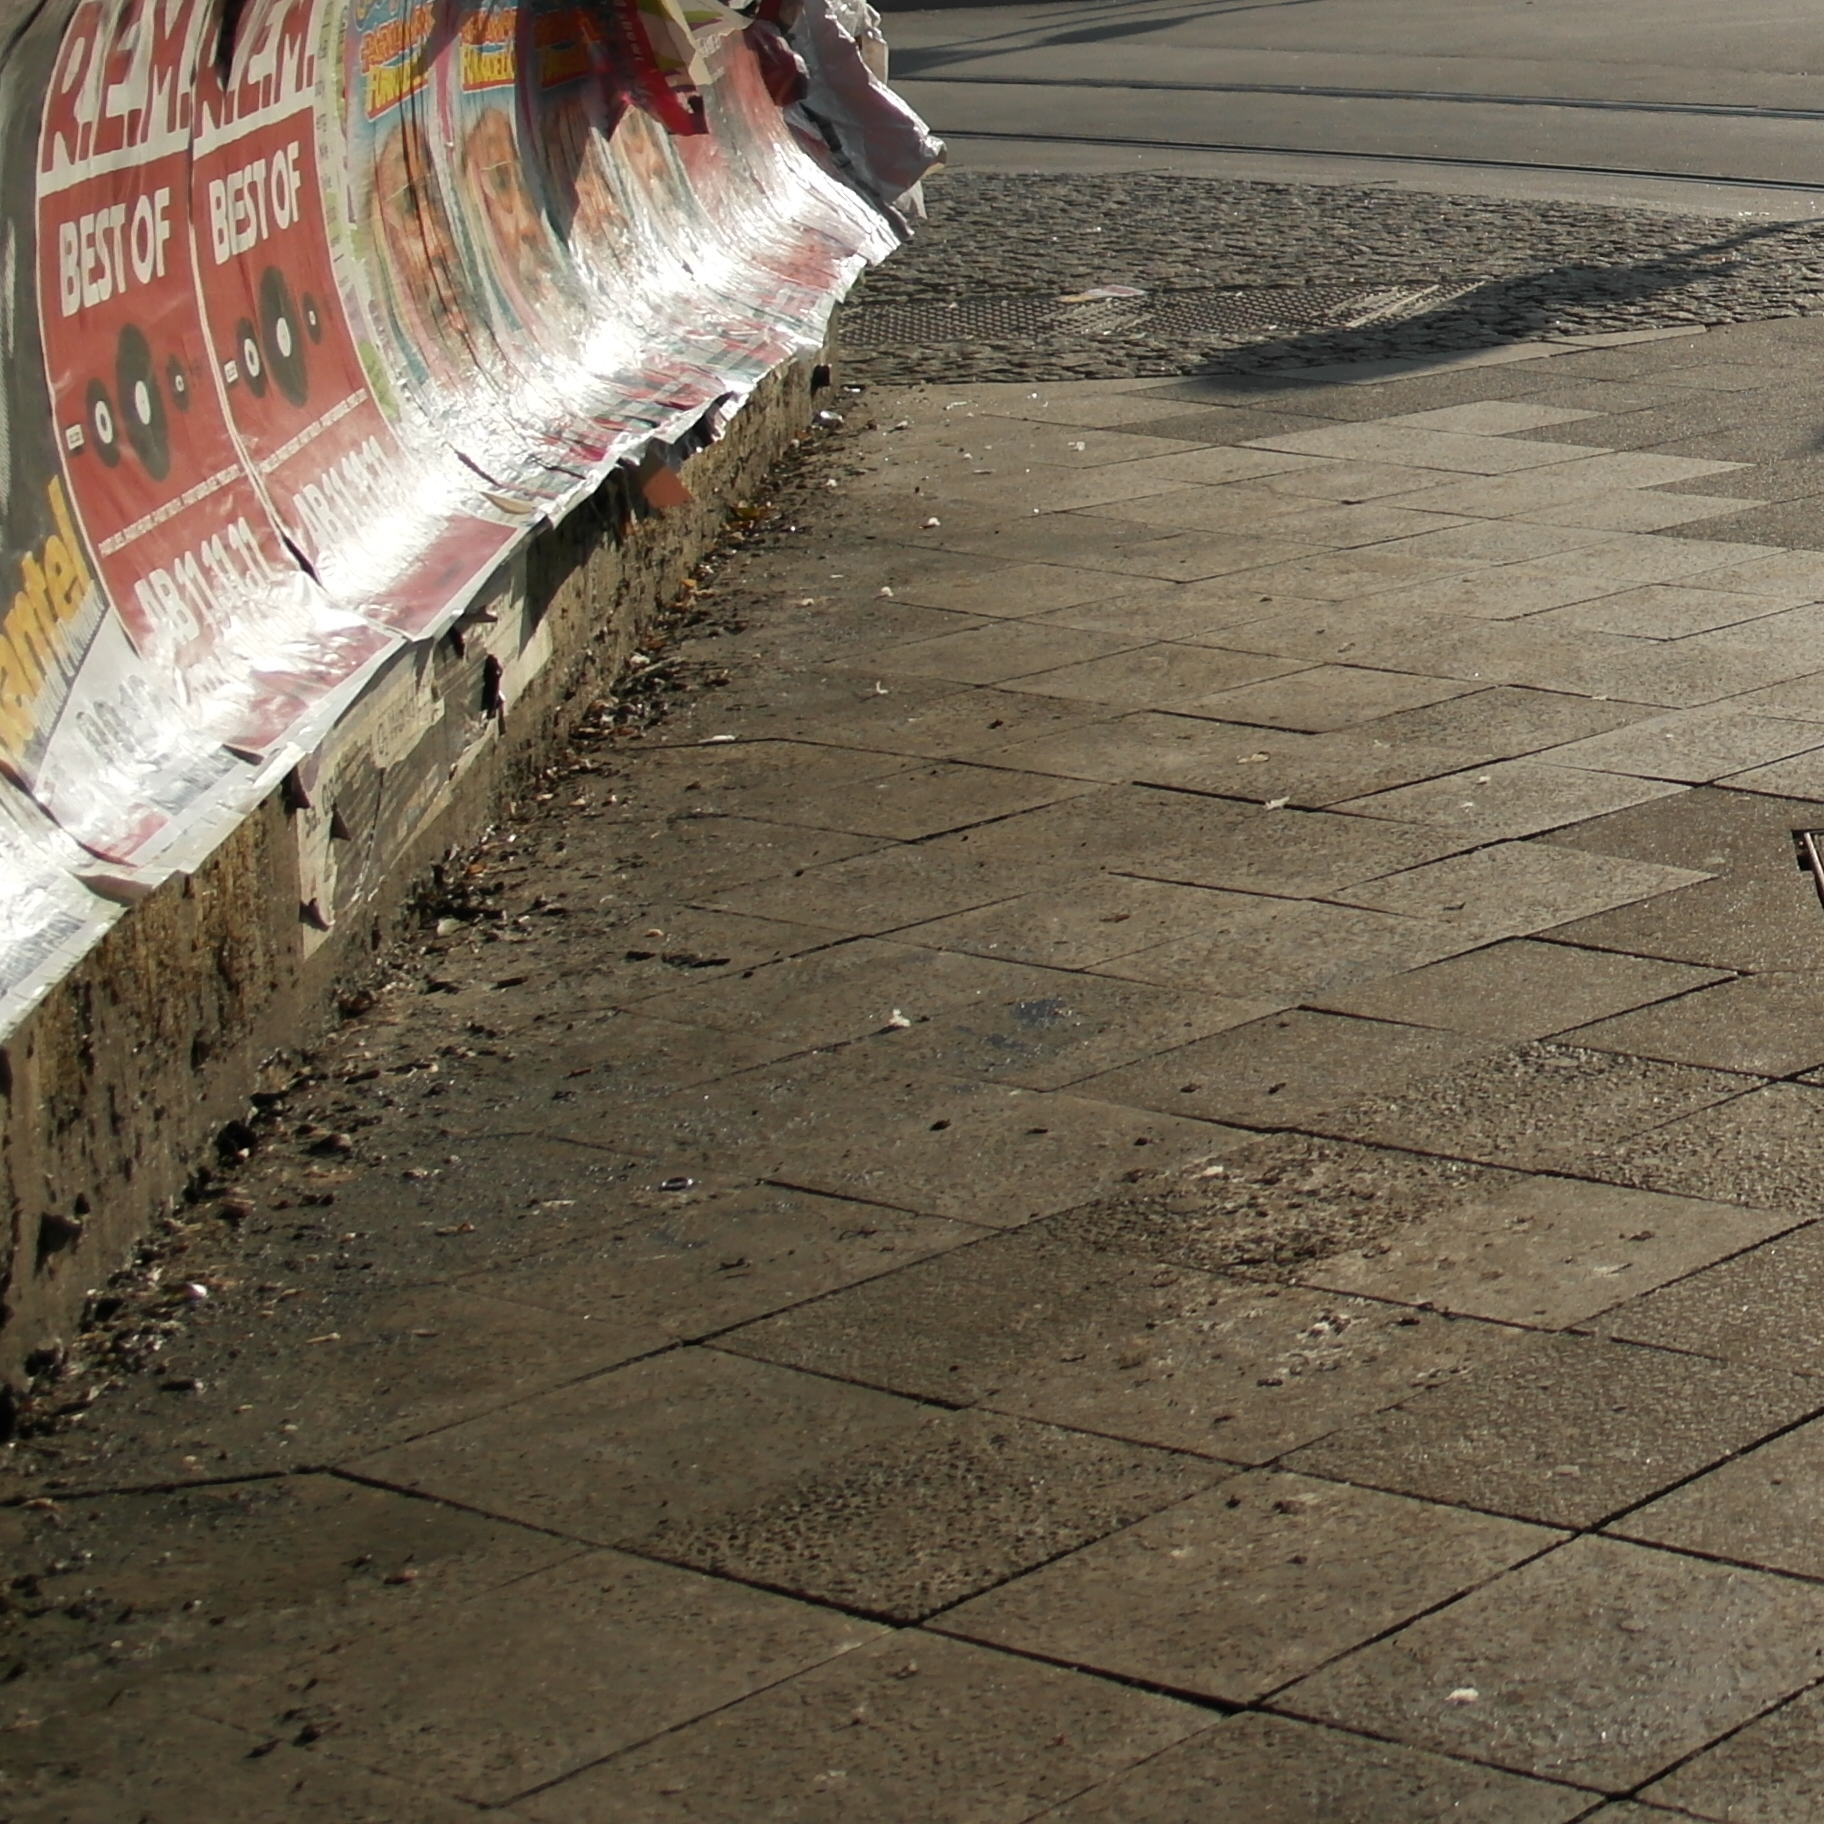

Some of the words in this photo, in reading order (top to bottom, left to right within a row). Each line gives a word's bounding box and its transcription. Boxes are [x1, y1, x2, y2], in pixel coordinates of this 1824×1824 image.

[58, 202, 127, 318] BEST
[130, 187, 170, 285] OF
[208, 159, 269, 266] BEST
[271, 142, 301, 230] OF
